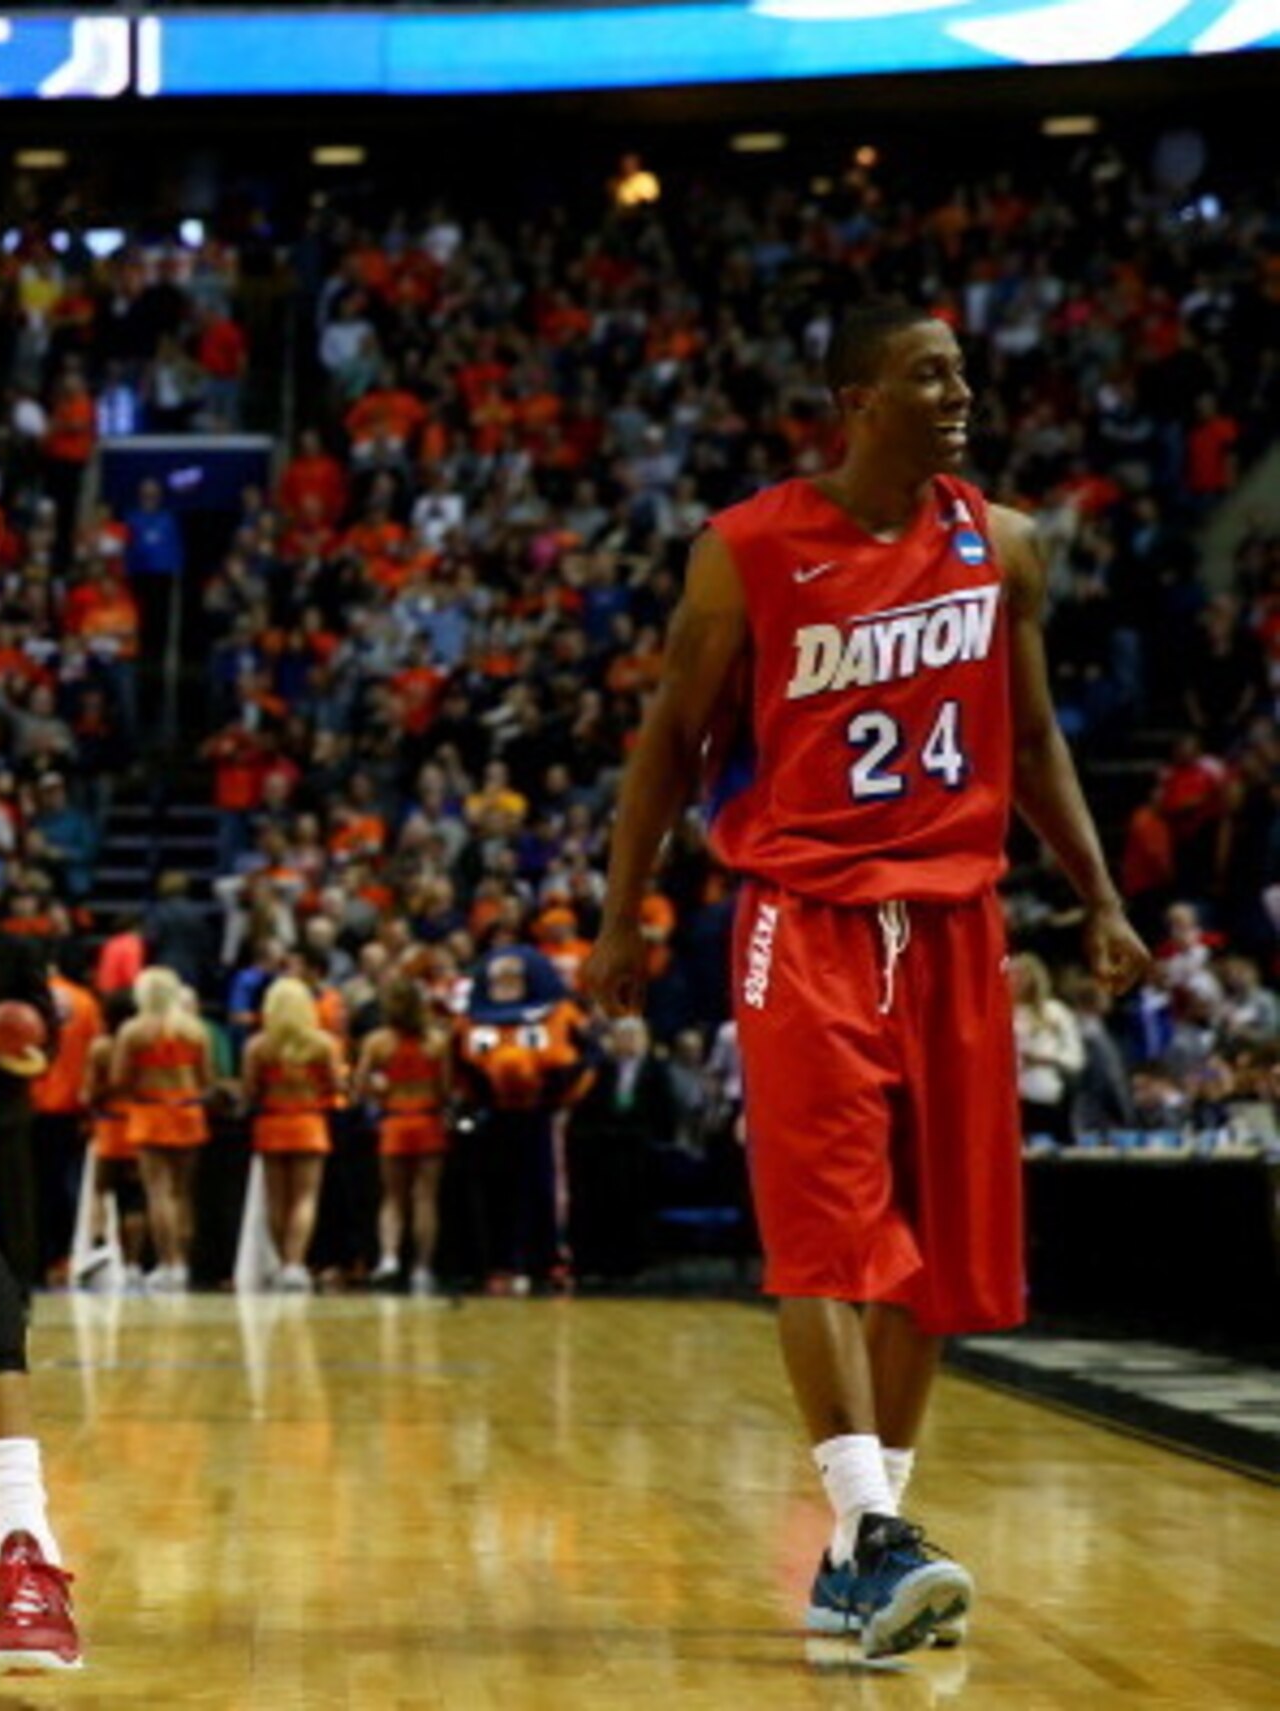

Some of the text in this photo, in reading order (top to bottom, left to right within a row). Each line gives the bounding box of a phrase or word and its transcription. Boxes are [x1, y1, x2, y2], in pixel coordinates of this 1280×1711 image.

[786, 583, 1001, 700] DAYTON
[846, 699, 966, 800] 24
[744, 903, 779, 1010] FLYERS
